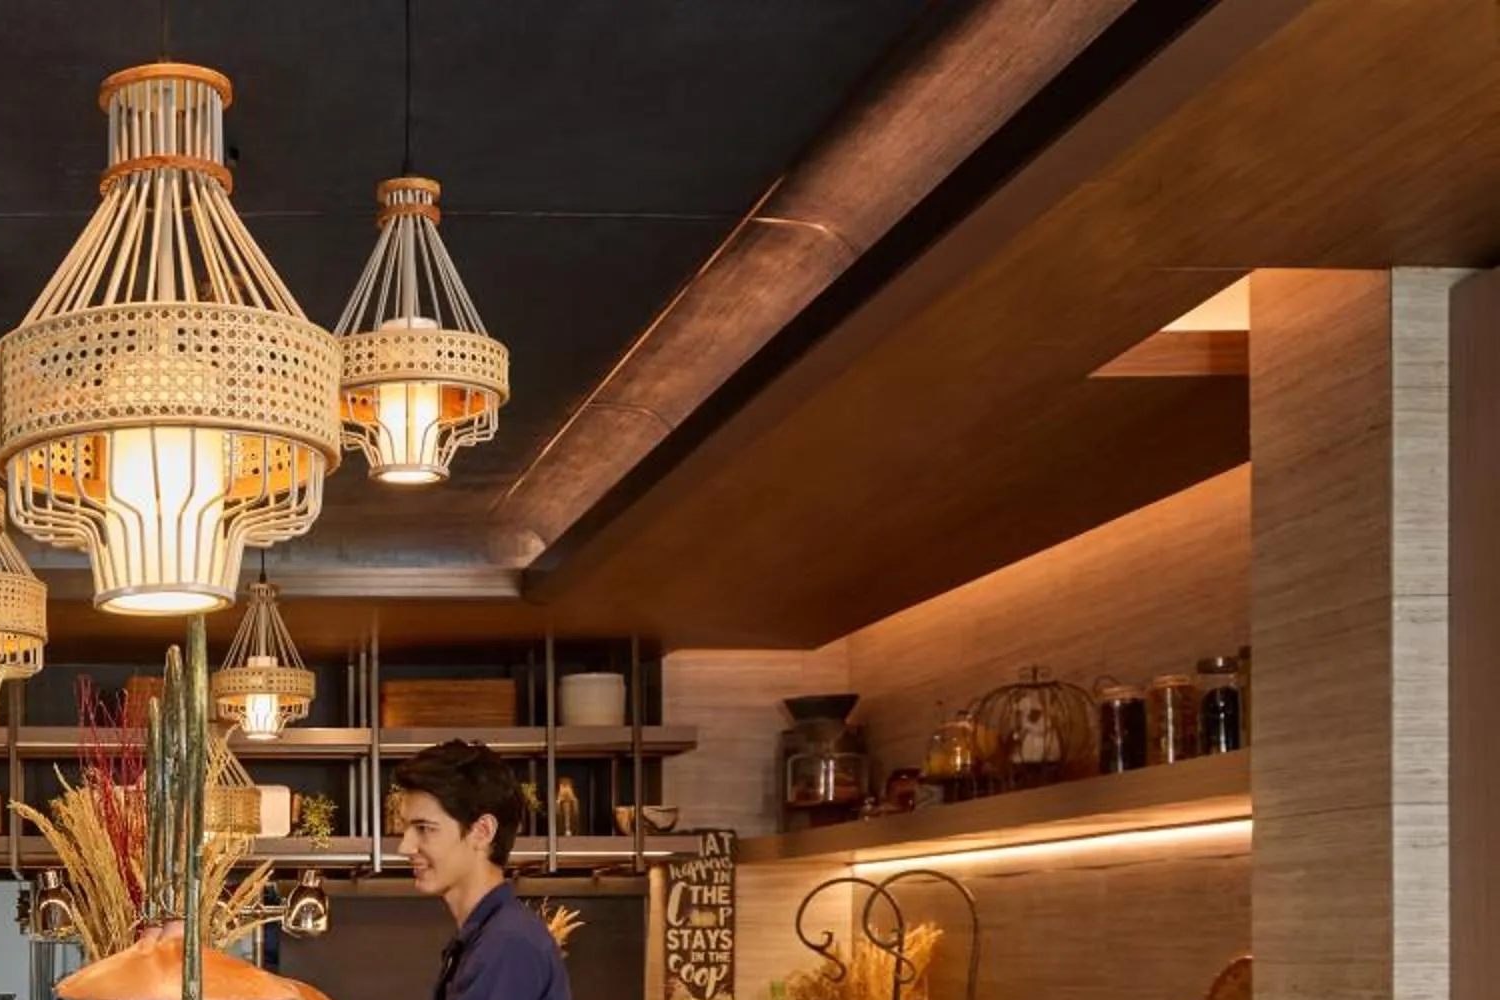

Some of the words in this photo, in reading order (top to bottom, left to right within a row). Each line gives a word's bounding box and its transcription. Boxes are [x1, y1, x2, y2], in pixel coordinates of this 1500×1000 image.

[713, 871, 732, 884] IN
[690, 885, 730, 905] THE
[666, 929, 733, 951] STAYS
[691, 952, 705, 963] IN
[708, 951, 731, 963] THE
